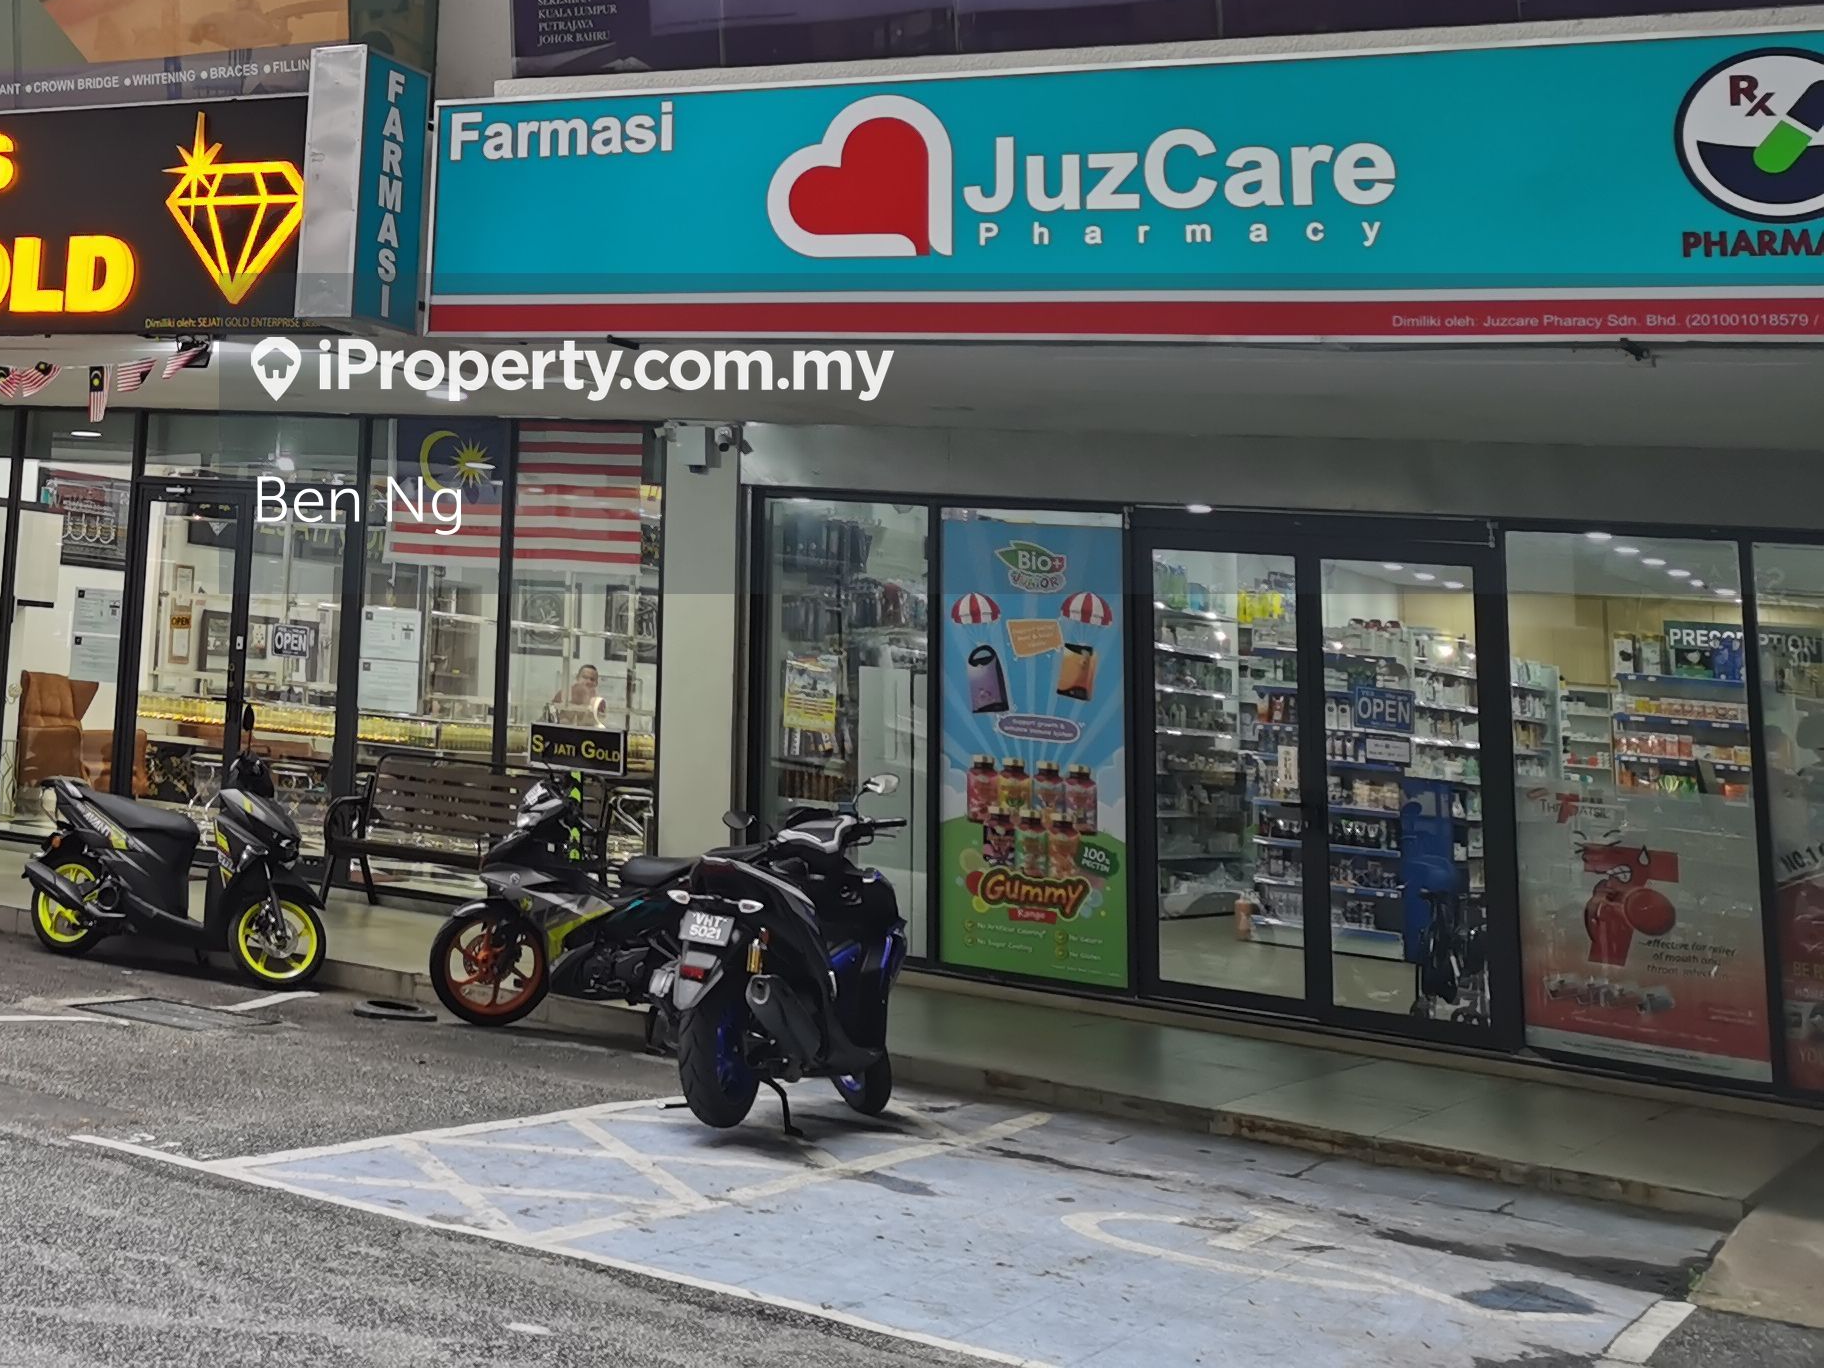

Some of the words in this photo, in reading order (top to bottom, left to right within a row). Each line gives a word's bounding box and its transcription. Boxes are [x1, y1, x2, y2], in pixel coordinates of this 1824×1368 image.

[538, 7, 572, 20] KUALA
[574, 4, 618, 17] LUMPUR
[538, 19, 594, 33] PUTRAJAYA
[537, 33, 574, 47] JOHOR
[576, 30, 610, 43] BAHRU
[33, 79, 75, 93] CROWN
[77, 76, 119, 90] BRIDGE
[132, 70, 196, 86] WHITENING
[210, 64, 259, 80] BRACES
[449, 100, 675, 161] Farmasi
[963, 127, 1396, 214] JuzCare
[376, 70, 405, 318] FARMASI
[979, 220, 1381, 247] Pharmacy
[144, 317, 175, 329] Dimiliki
[197, 316, 223, 328] SEJATI
[226, 317, 250, 328] GOLD
[251, 317, 301, 328] ENTERPRISE
[1392, 314, 1442, 327] Dimiliki
[1483, 315, 1539, 327] Juzcare
[1543, 315, 1602, 329] Pharacy
[1607, 314, 1638, 327] Sdn.
[1646, 314, 1678, 327] Bhd.
[1685, 313, 1809, 330] (201001018579
[171, 616, 191, 626] OPEN
[275, 632, 307, 652] OPEN
[1358, 697, 1410, 724] OPEN
[532, 734, 576, 757] SJATI
[581, 740, 620, 762] GOLD
[1081, 859, 1110, 872] PECTIN
[984, 873, 1083, 914] Gummy
[694, 912, 723, 927] VHT
[689, 924, 722, 940] 5021
